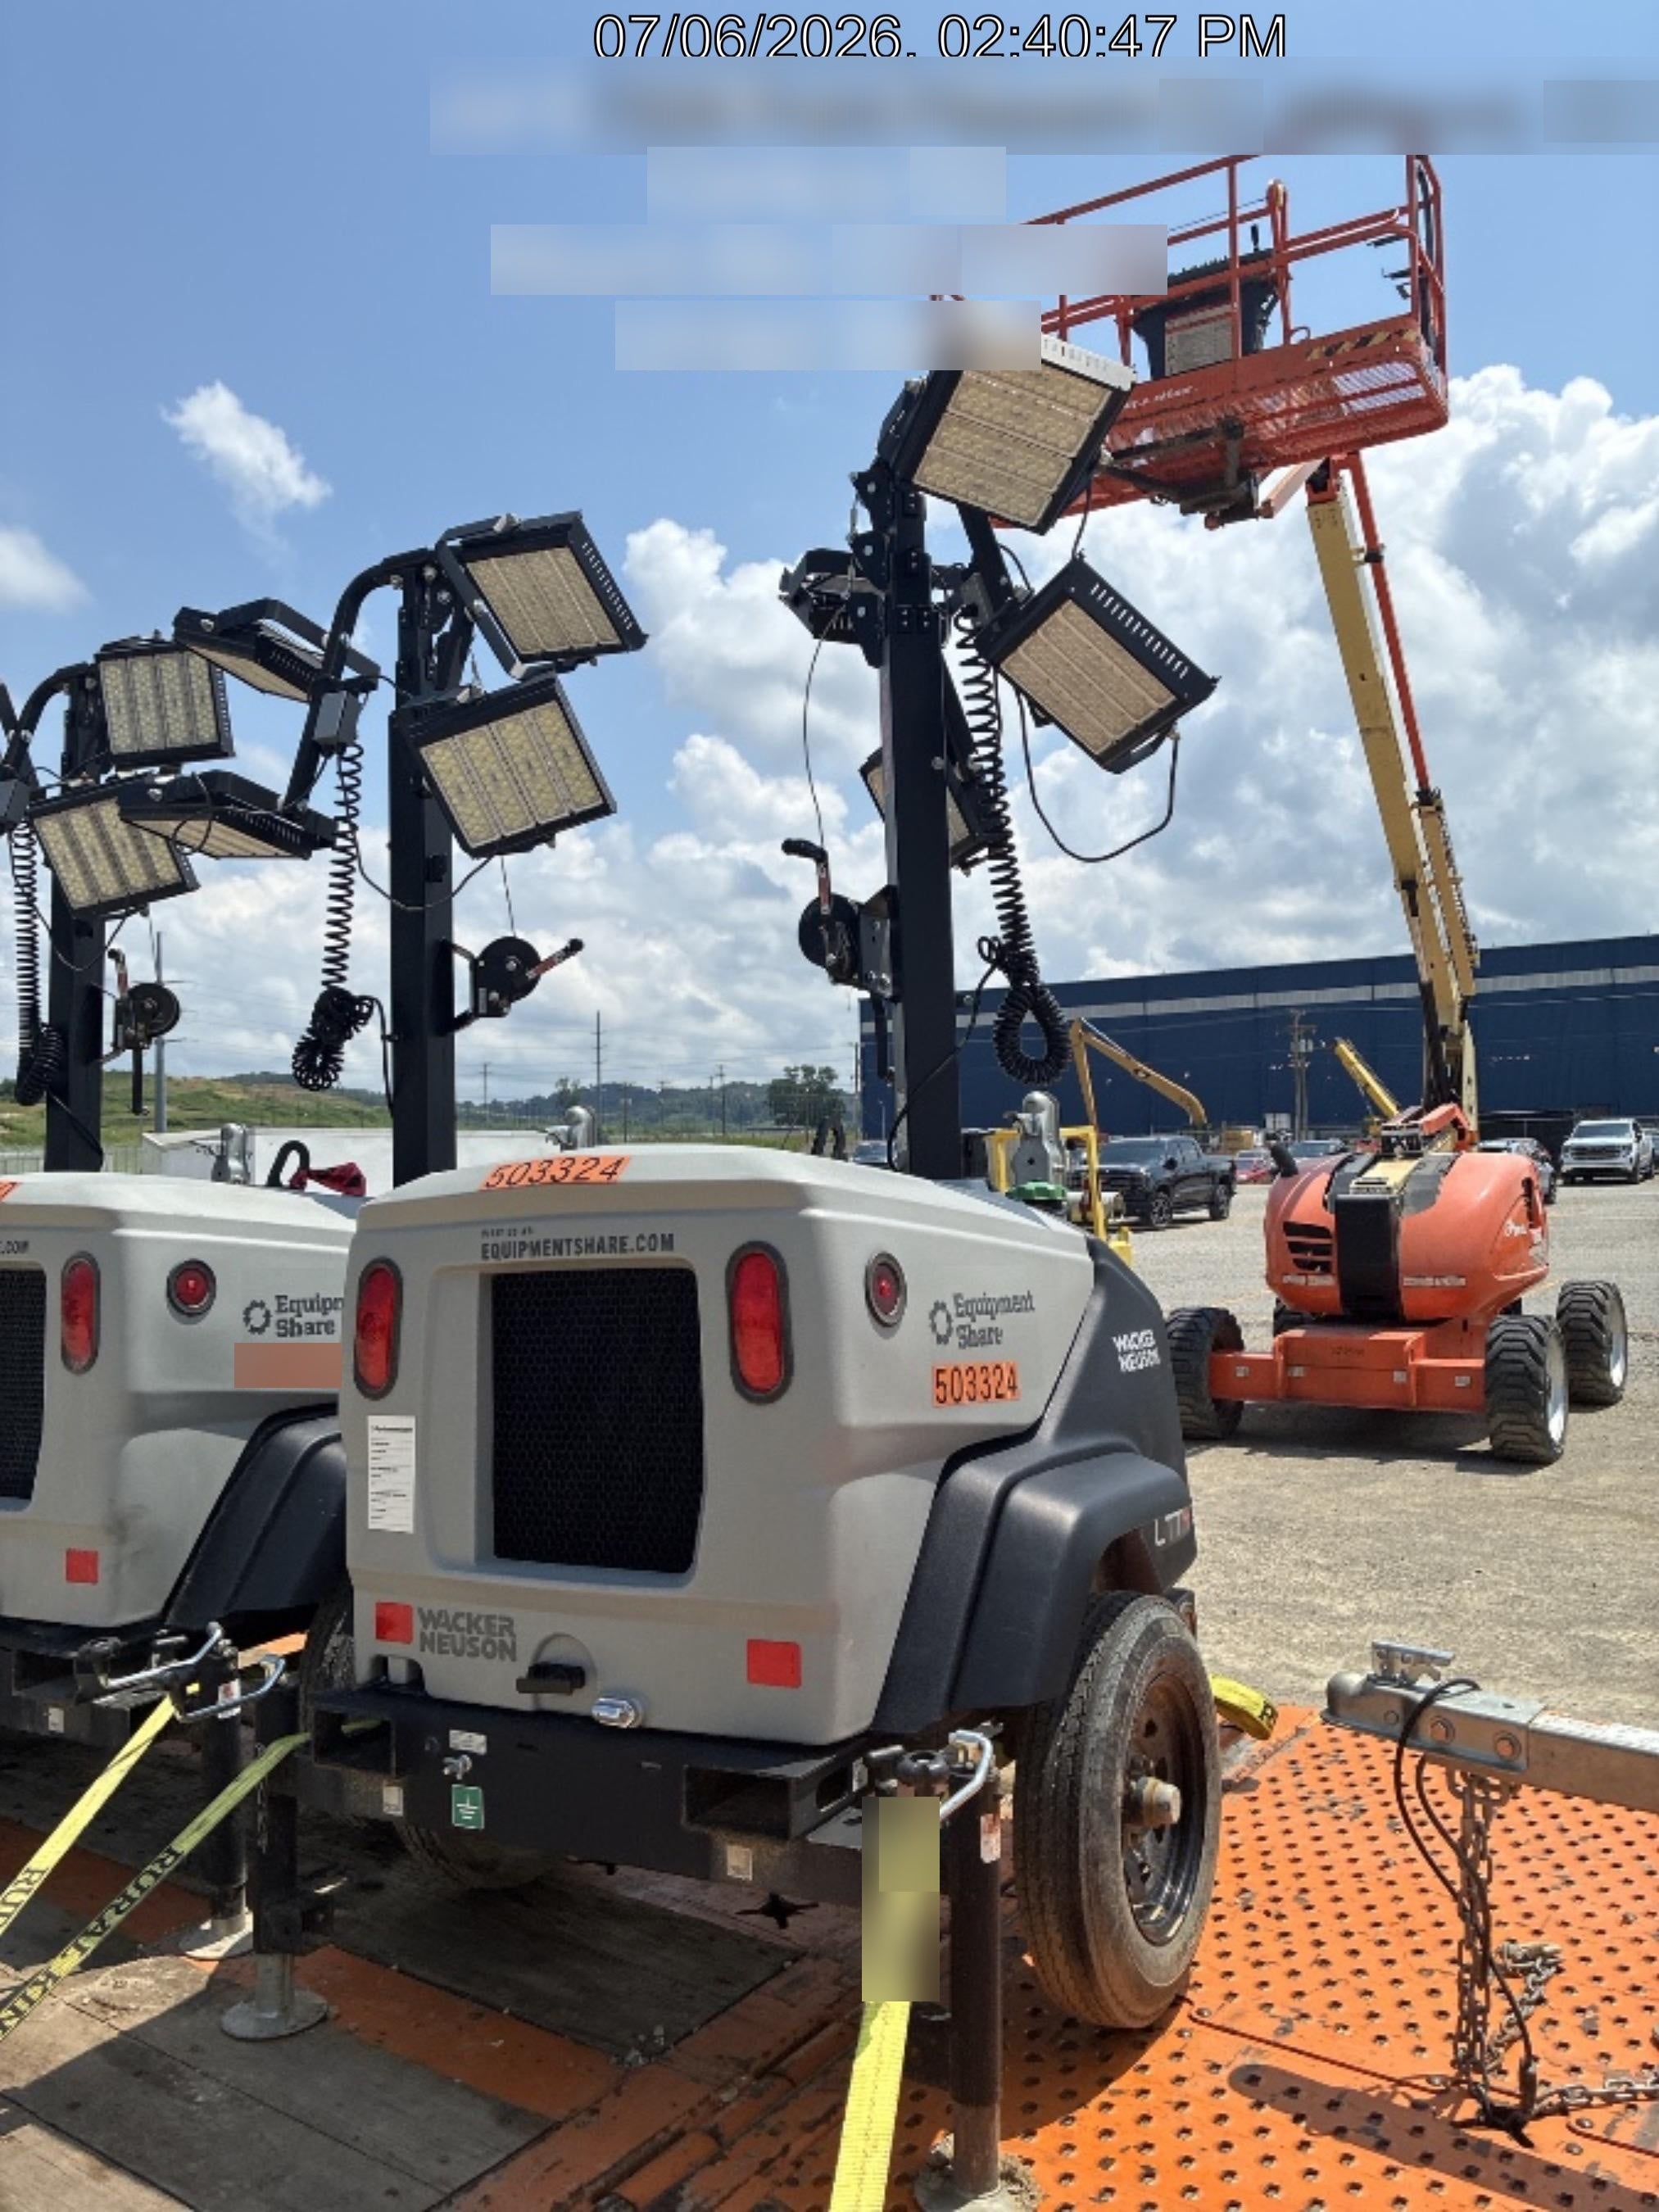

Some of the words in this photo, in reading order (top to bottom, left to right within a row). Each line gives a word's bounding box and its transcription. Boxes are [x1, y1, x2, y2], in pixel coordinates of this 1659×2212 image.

[485, 1157, 624, 1188] 503324
[481, 1233, 674, 1260] EQUIPMENTSHARE.COM
[953, 1290, 1036, 1322] Equipment
[276, 1317, 335, 1337] Share
[956, 1324, 1004, 1349] Share
[936, 1363, 1018, 1403] 503324
[418, 1607, 516, 1638] WACKER
[419, 1631, 517, 1662] NEUSON
[61, 1844, 185, 1958] RURAL
[0, 1968, 61, 2037] KIN
